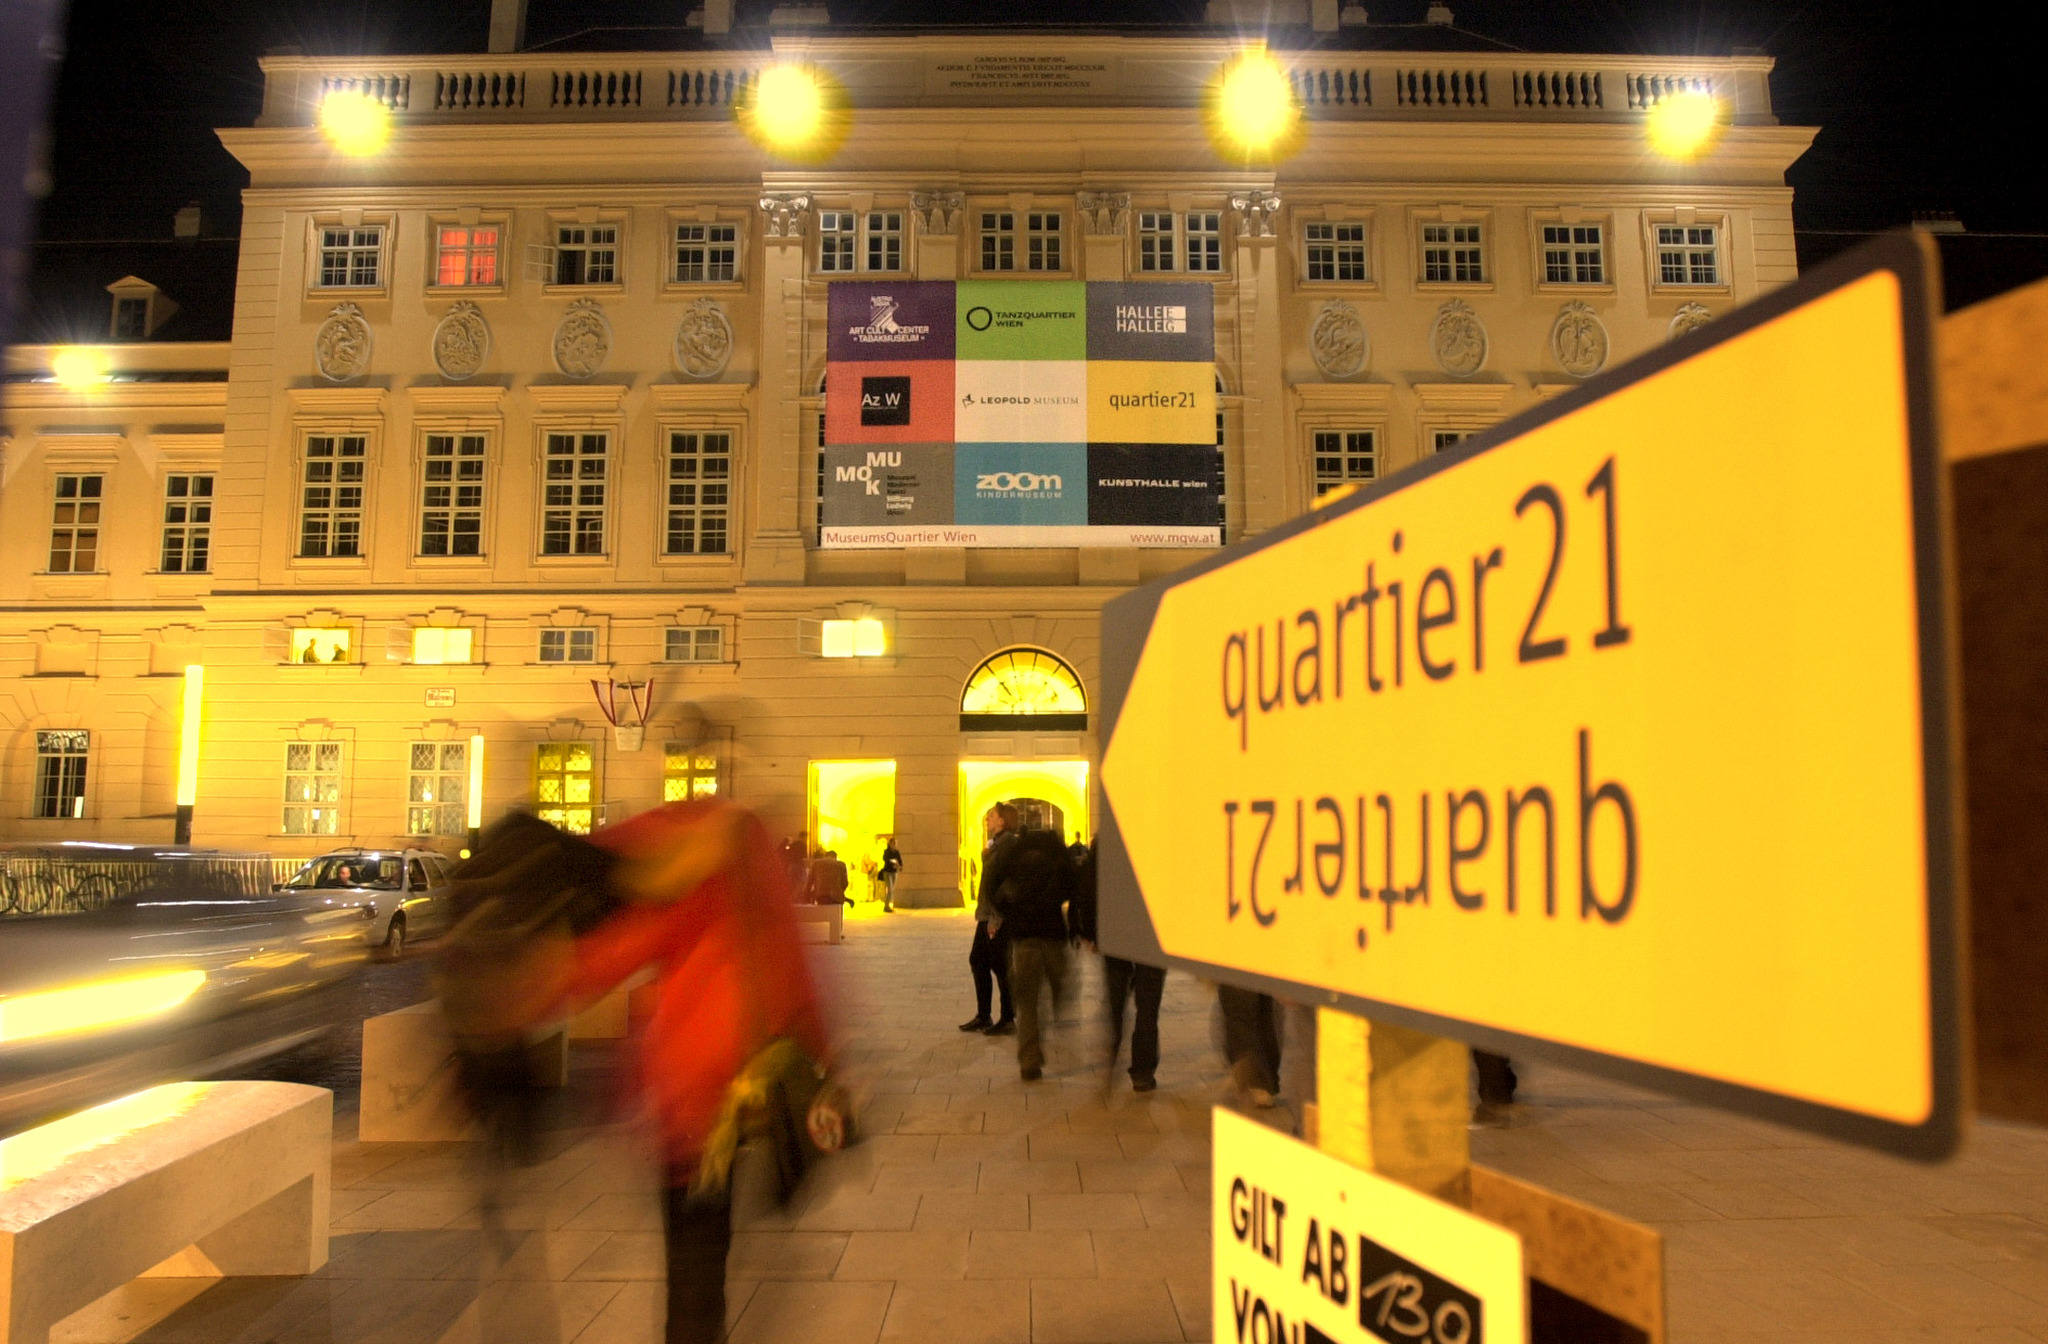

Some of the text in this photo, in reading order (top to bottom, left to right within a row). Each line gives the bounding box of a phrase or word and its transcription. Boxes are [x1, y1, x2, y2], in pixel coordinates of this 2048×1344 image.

[996, 311, 1076, 320] TANZQUARTIER
[898, 325, 930, 334] CENTER
[858, 334, 920, 342] TABAKMUSEUM
[980, 396, 1079, 405] LEOPOLD MUSEUM
[1109, 391, 1195, 411] quartier21
[866, 452, 902, 467] MU
[1098, 478, 1180, 488] KUNSTHALLE
[976, 491, 1062, 499] KINDERMUSEUM
[826, 531, 977, 545] MuseumsQuartier Wien
[1130, 532, 1216, 545] www.mqw.at
[1222, 453, 1634, 750] quartier21
[1224, 727, 1640, 950] quartier21
[1230, 1177, 1286, 1268] GILT
[1302, 1216, 1350, 1308] AB
